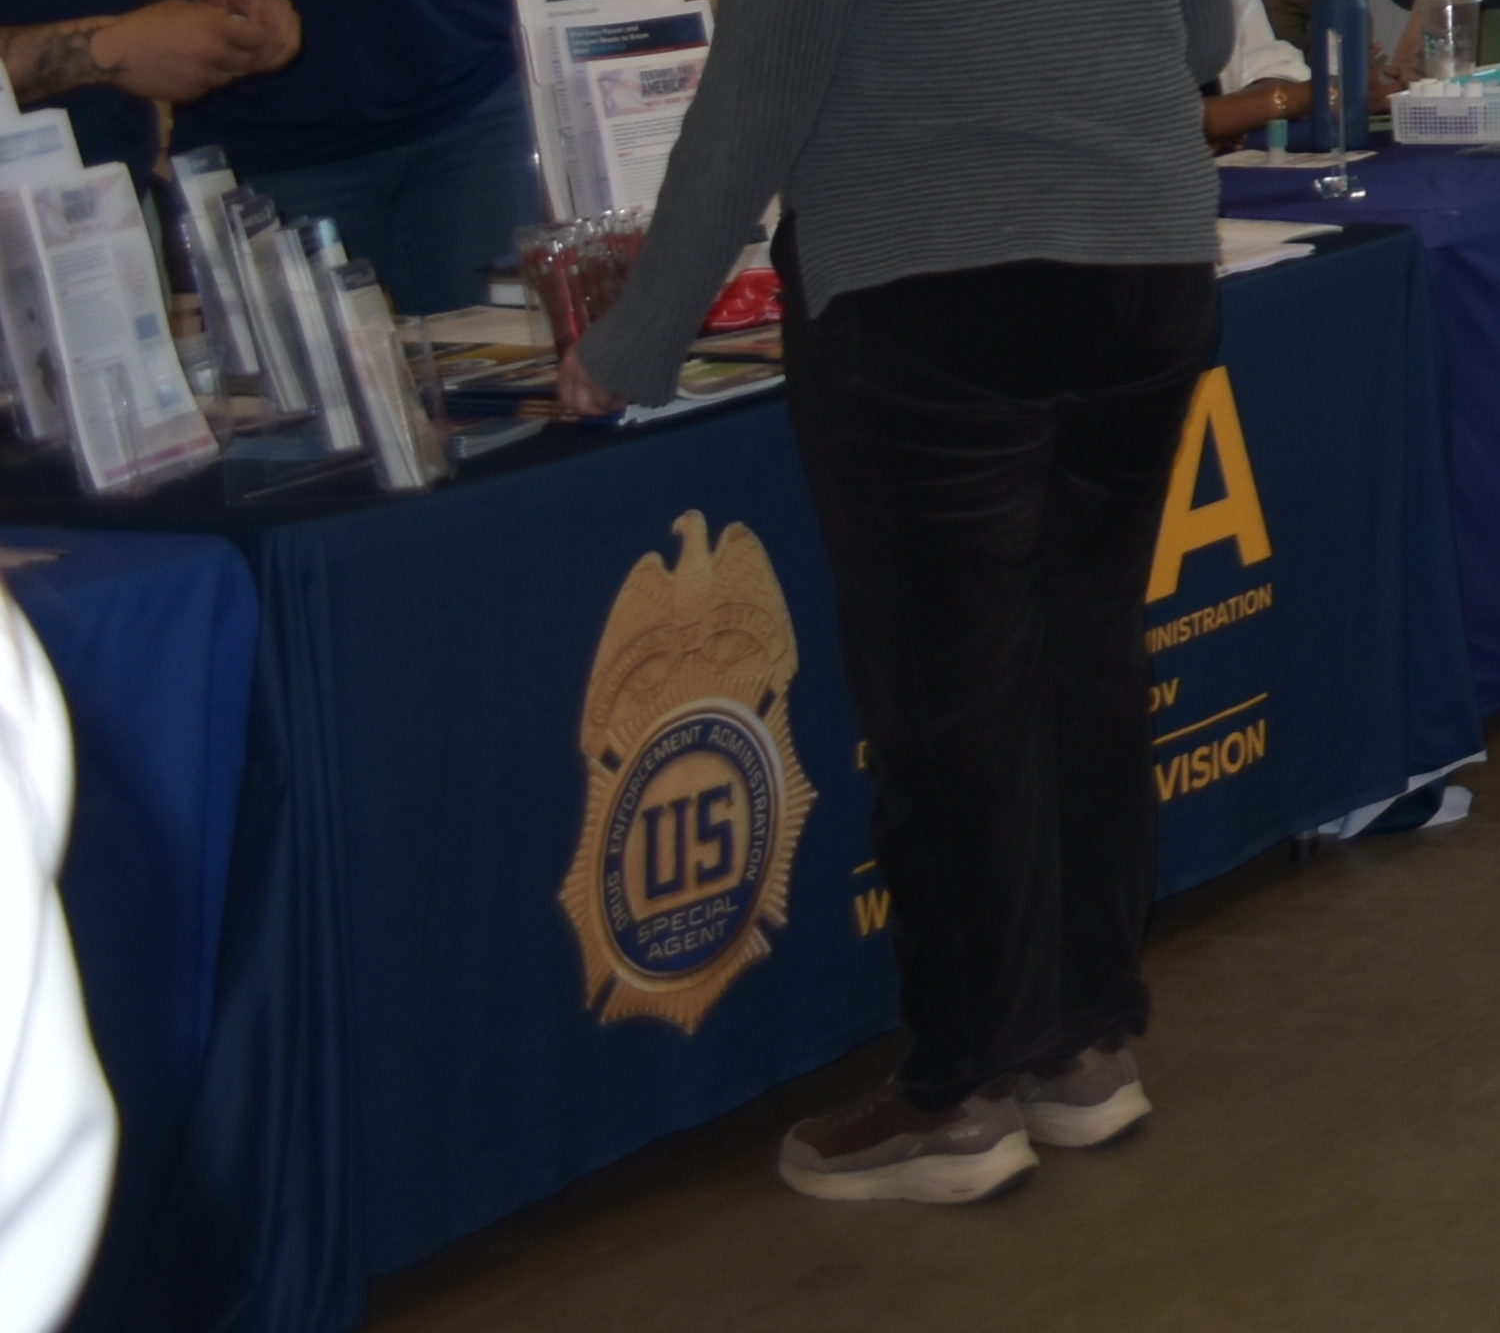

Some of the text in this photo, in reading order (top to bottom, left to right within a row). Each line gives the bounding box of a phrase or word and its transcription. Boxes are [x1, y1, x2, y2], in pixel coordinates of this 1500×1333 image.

[609, 724, 767, 881] ENFORCEMENT ADMINISTRATION
[641, 783, 734, 900] US
[606, 871, 630, 932] DRUG
[637, 894, 739, 945] SPECIAL
[646, 918, 728, 963] AGENT
